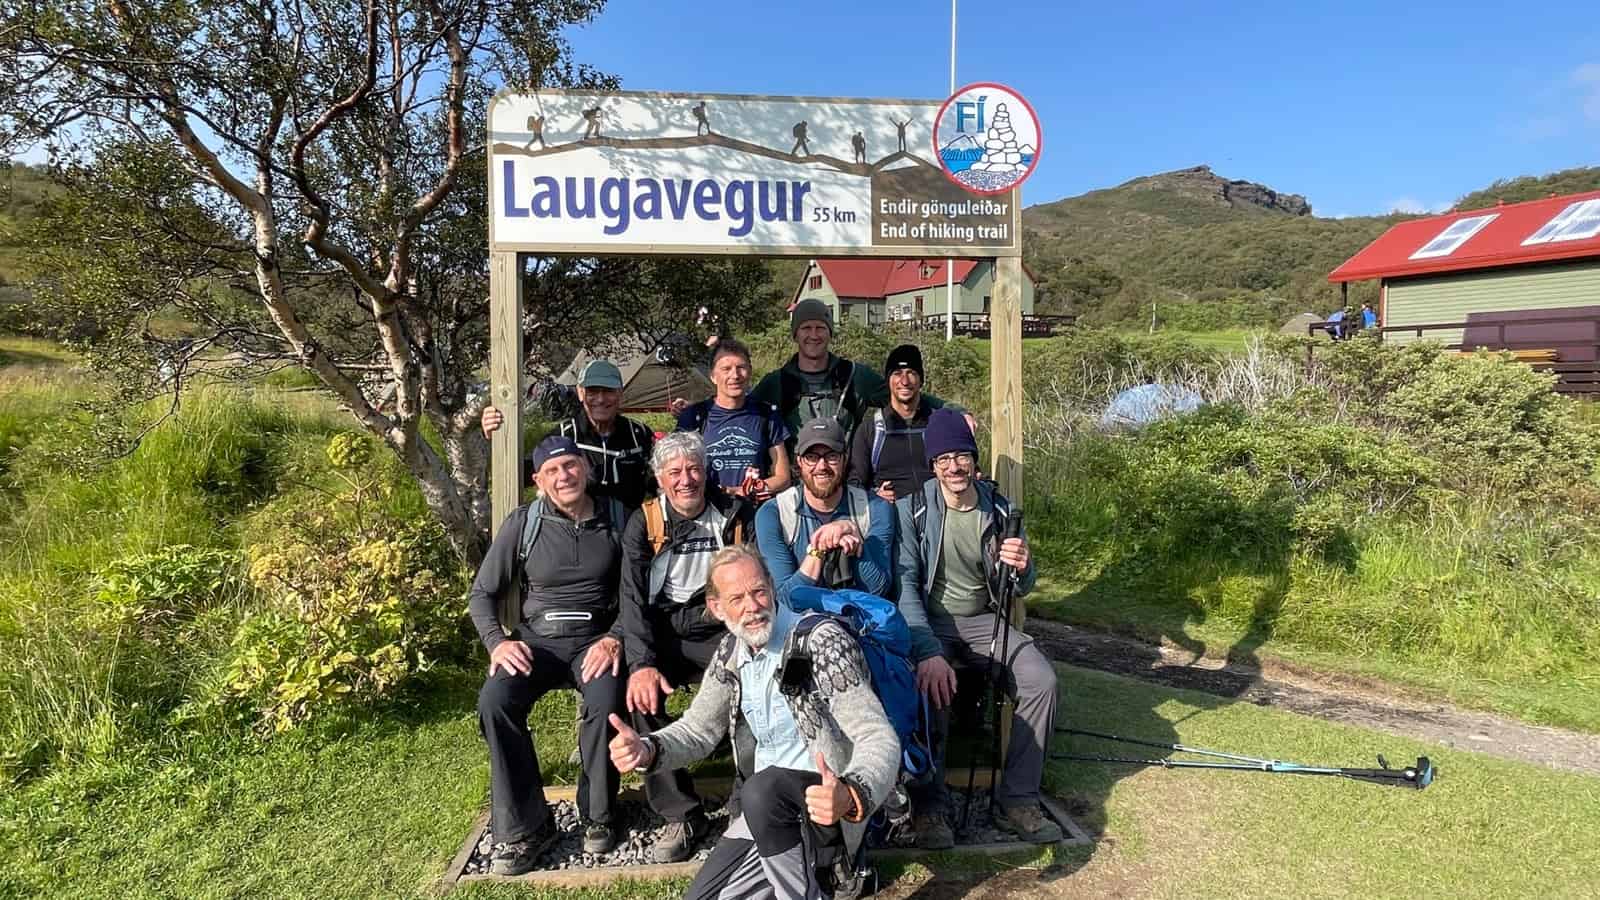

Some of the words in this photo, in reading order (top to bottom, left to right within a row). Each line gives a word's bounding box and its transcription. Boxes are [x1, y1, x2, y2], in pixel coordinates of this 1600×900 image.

[955, 96, 987, 133] FÍ
[503, 160, 811, 236] Laugavegur
[812, 207, 830, 222] 55
[834, 206, 856, 223] km
[879, 198, 918, 215] Endir
[921, 199, 1008, 218] gönguleiðar
[879, 222, 907, 238] End
[910, 222, 928, 239] of
[929, 222, 974, 242] hiking
[977, 223, 1008, 239] trail
